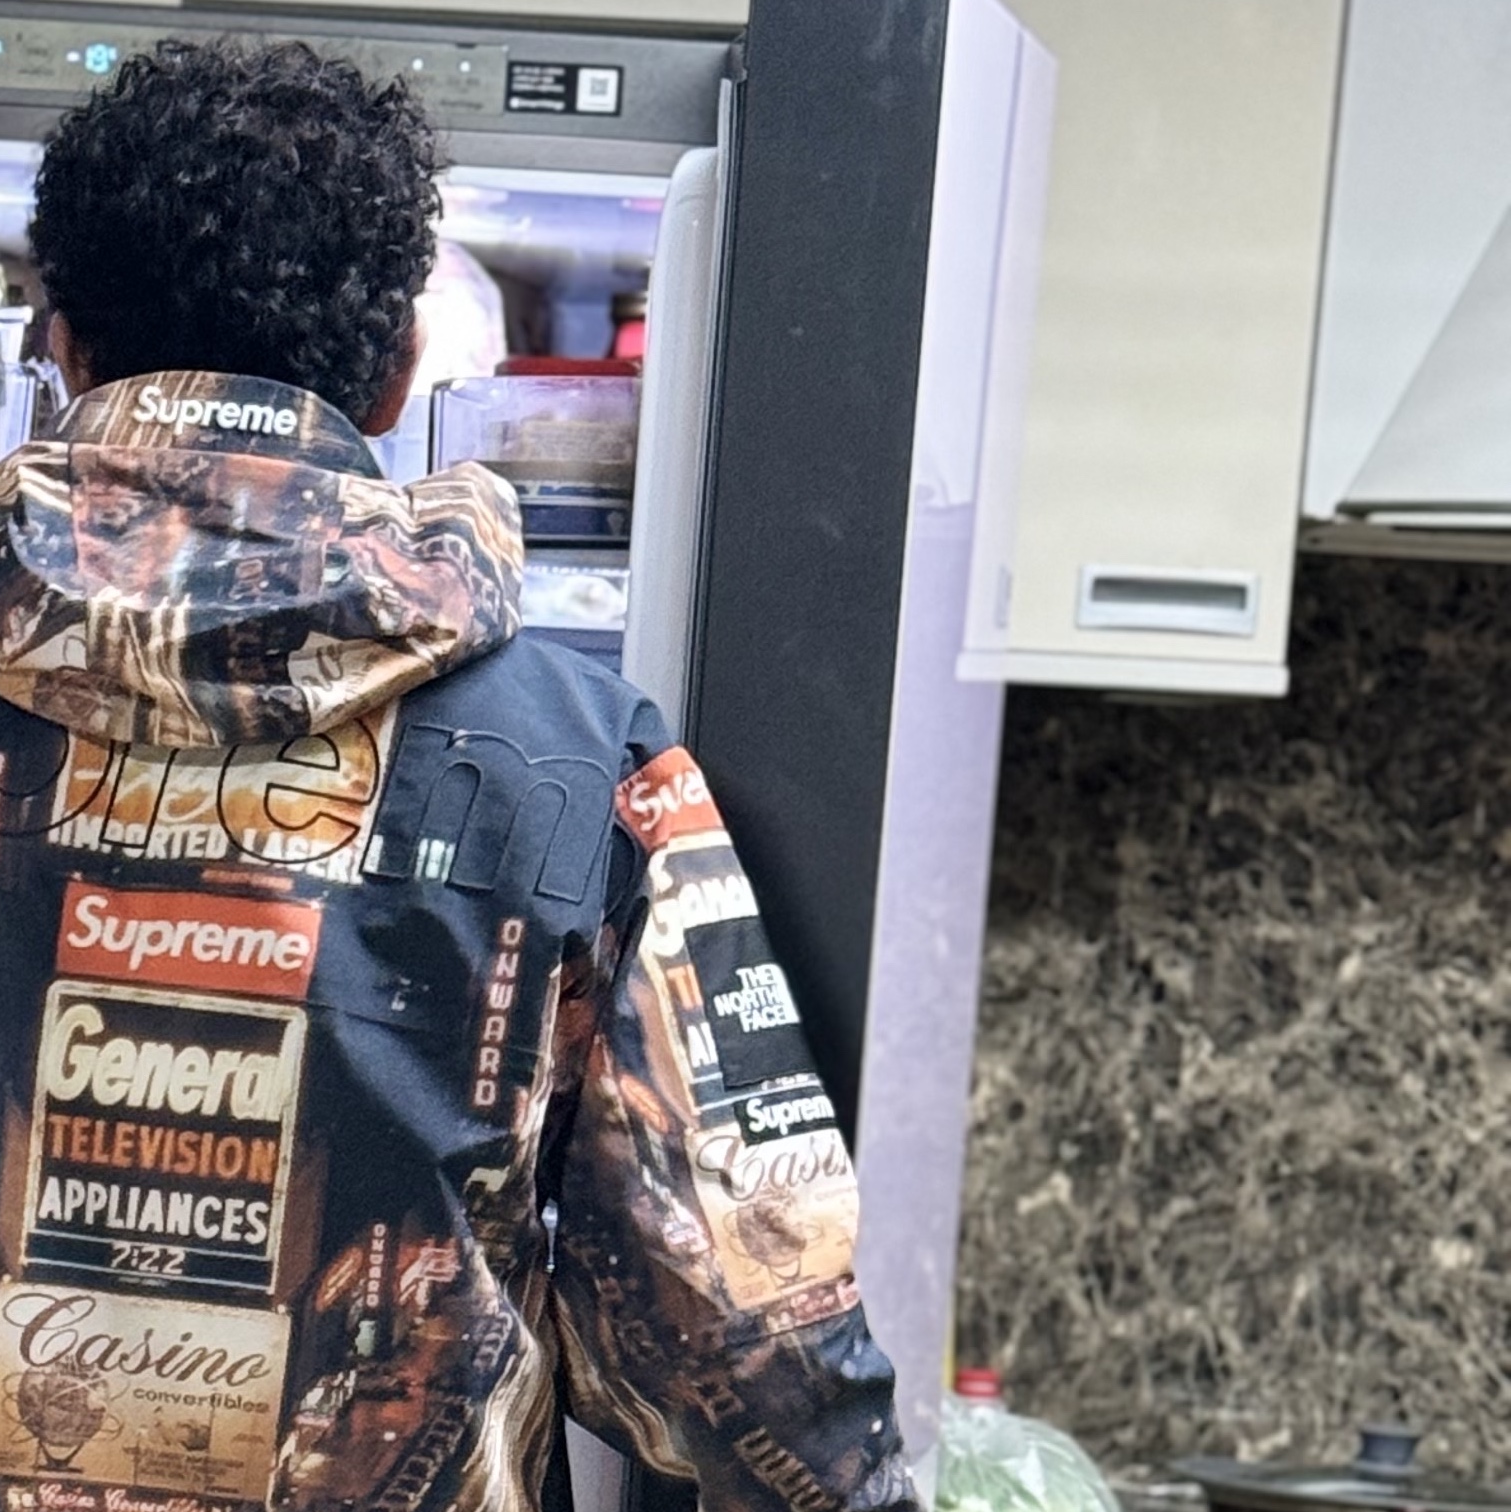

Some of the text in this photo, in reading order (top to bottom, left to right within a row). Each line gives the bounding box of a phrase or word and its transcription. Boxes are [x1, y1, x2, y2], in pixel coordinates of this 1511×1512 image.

[133, 385, 298, 436] Supreme
[65, 892, 311, 972] Supreme
[474, 918, 525, 1107] ONWARD
[45, 1003, 286, 1121] General
[47, 1115, 276, 1184] TELEVISION
[38, 1177, 270, 1245] APPLIANCES
[2, 1290, 272, 1388] Casino
[132, 1386, 272, 1414] convertibles
